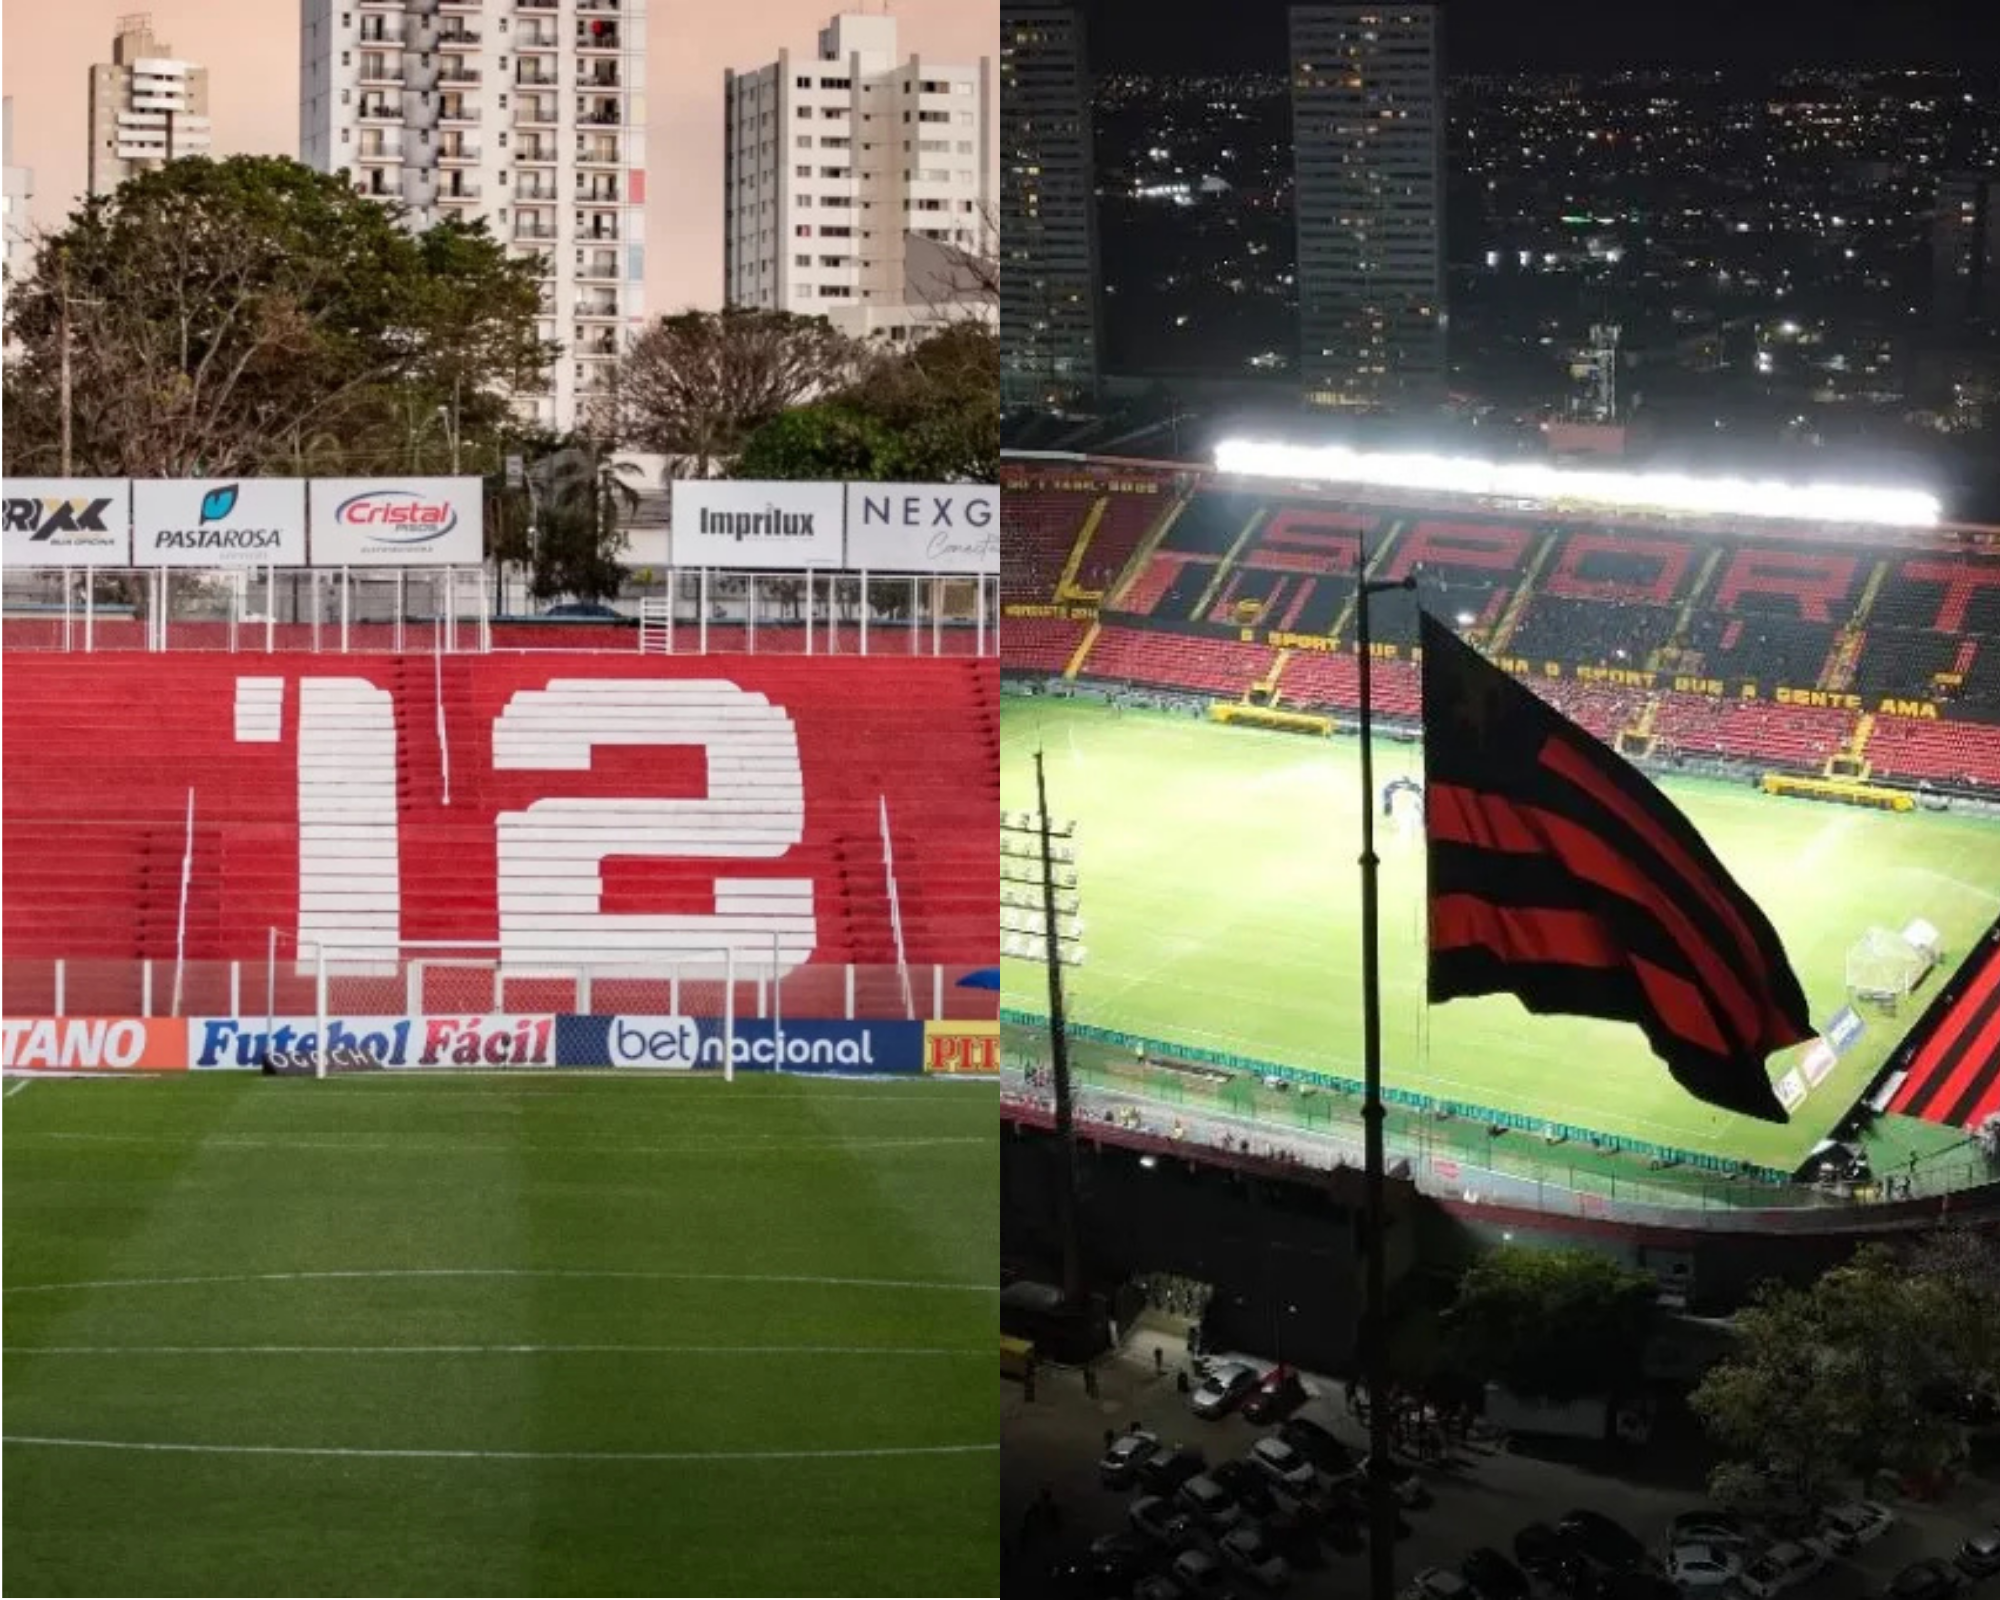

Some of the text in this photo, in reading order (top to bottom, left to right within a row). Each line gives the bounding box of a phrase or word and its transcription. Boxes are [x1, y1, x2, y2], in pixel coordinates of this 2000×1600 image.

[346, 501, 449, 524] Cristal
[700, 502, 814, 541] Imprilux
[863, 496, 992, 527] NEXG
[154, 529, 281, 548] PASTAROSA
[1248, 506, 2000, 642] SPORT
[1268, 631, 1341, 651] SPORT
[1776, 686, 1862, 708] GENTE
[1880, 699, 1937, 719] AMA
[2, 1018, 147, 1068] TANO
[196, 1018, 551, 1066] Futebol Fácil
